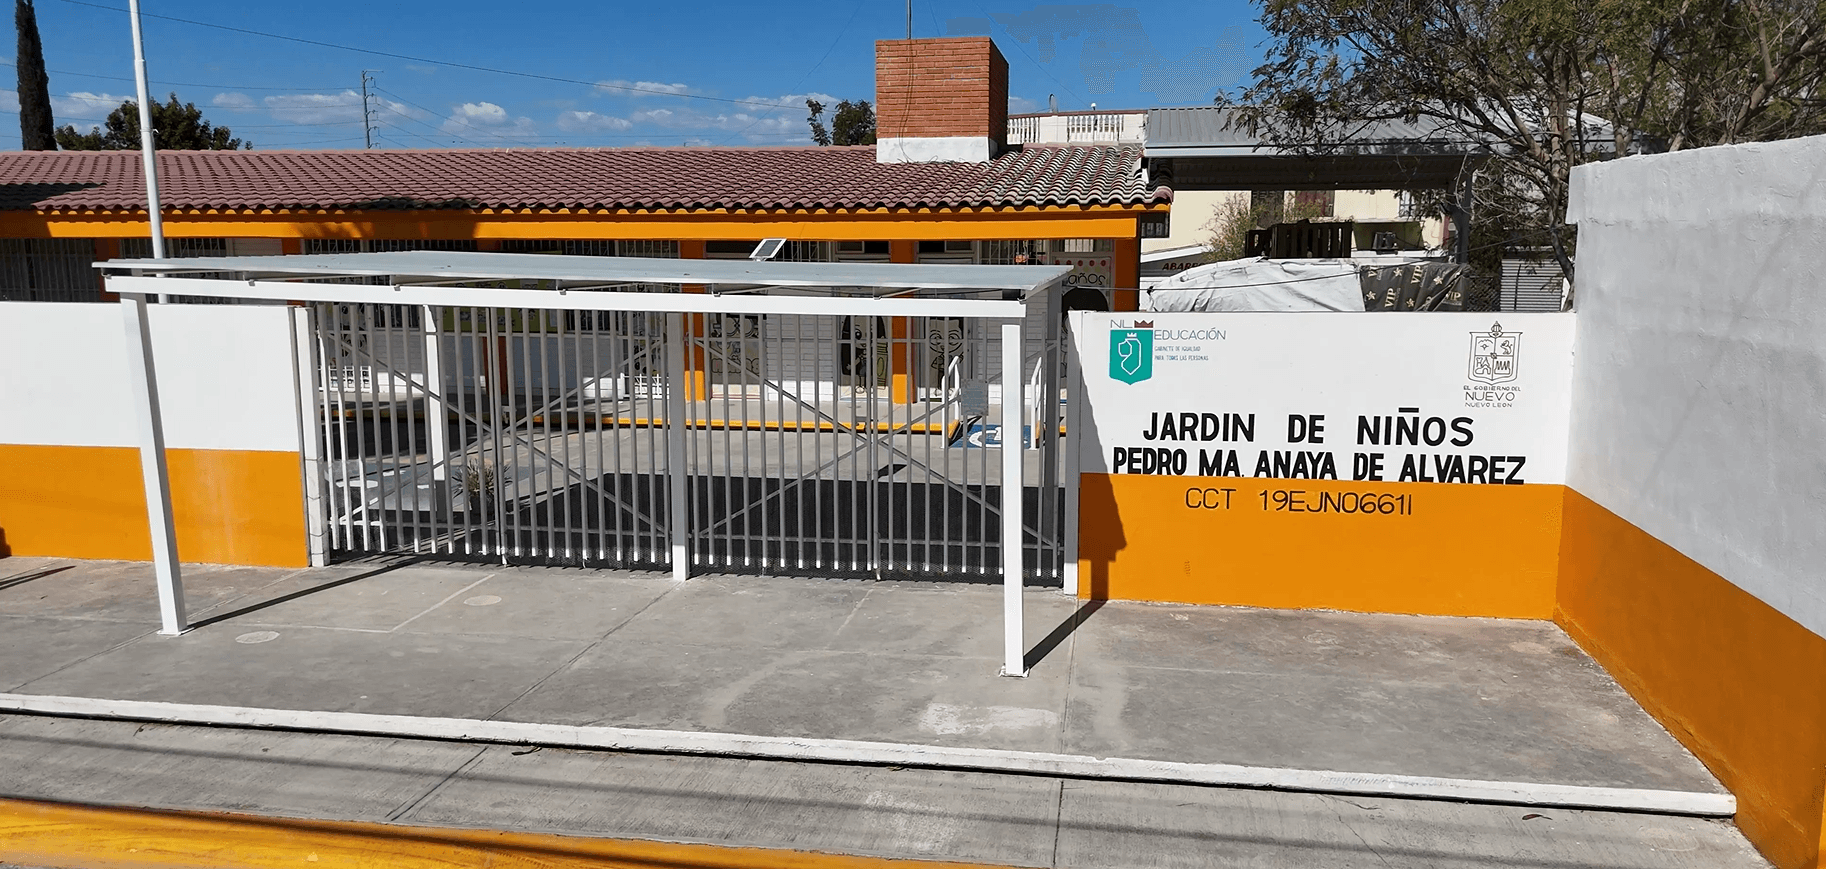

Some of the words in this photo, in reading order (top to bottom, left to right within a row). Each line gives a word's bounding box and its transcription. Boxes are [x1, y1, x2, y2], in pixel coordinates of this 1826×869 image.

[1067, 272, 1106, 286] años
[1410, 265, 1423, 284] VIP
[1384, 287, 1397, 308] VIP
[1110, 319, 1133, 328] NL
[1154, 327, 1227, 340] EDUCACIÓN
[1465, 391, 1515, 402] NUEVO
[1143, 412, 1256, 442] JARDIN
[1287, 414, 1325, 444] DE
[1356, 407, 1474, 447] NIÑOS
[1113, 446, 1188, 476] PEDRO
[1198, 448, 1245, 478] MA.
[1253, 450, 1338, 480] ANAYA
[1352, 452, 1385, 482] DE
[1398, 453, 1526, 485] ALVAREZ
[1185, 487, 1237, 510] CCT
